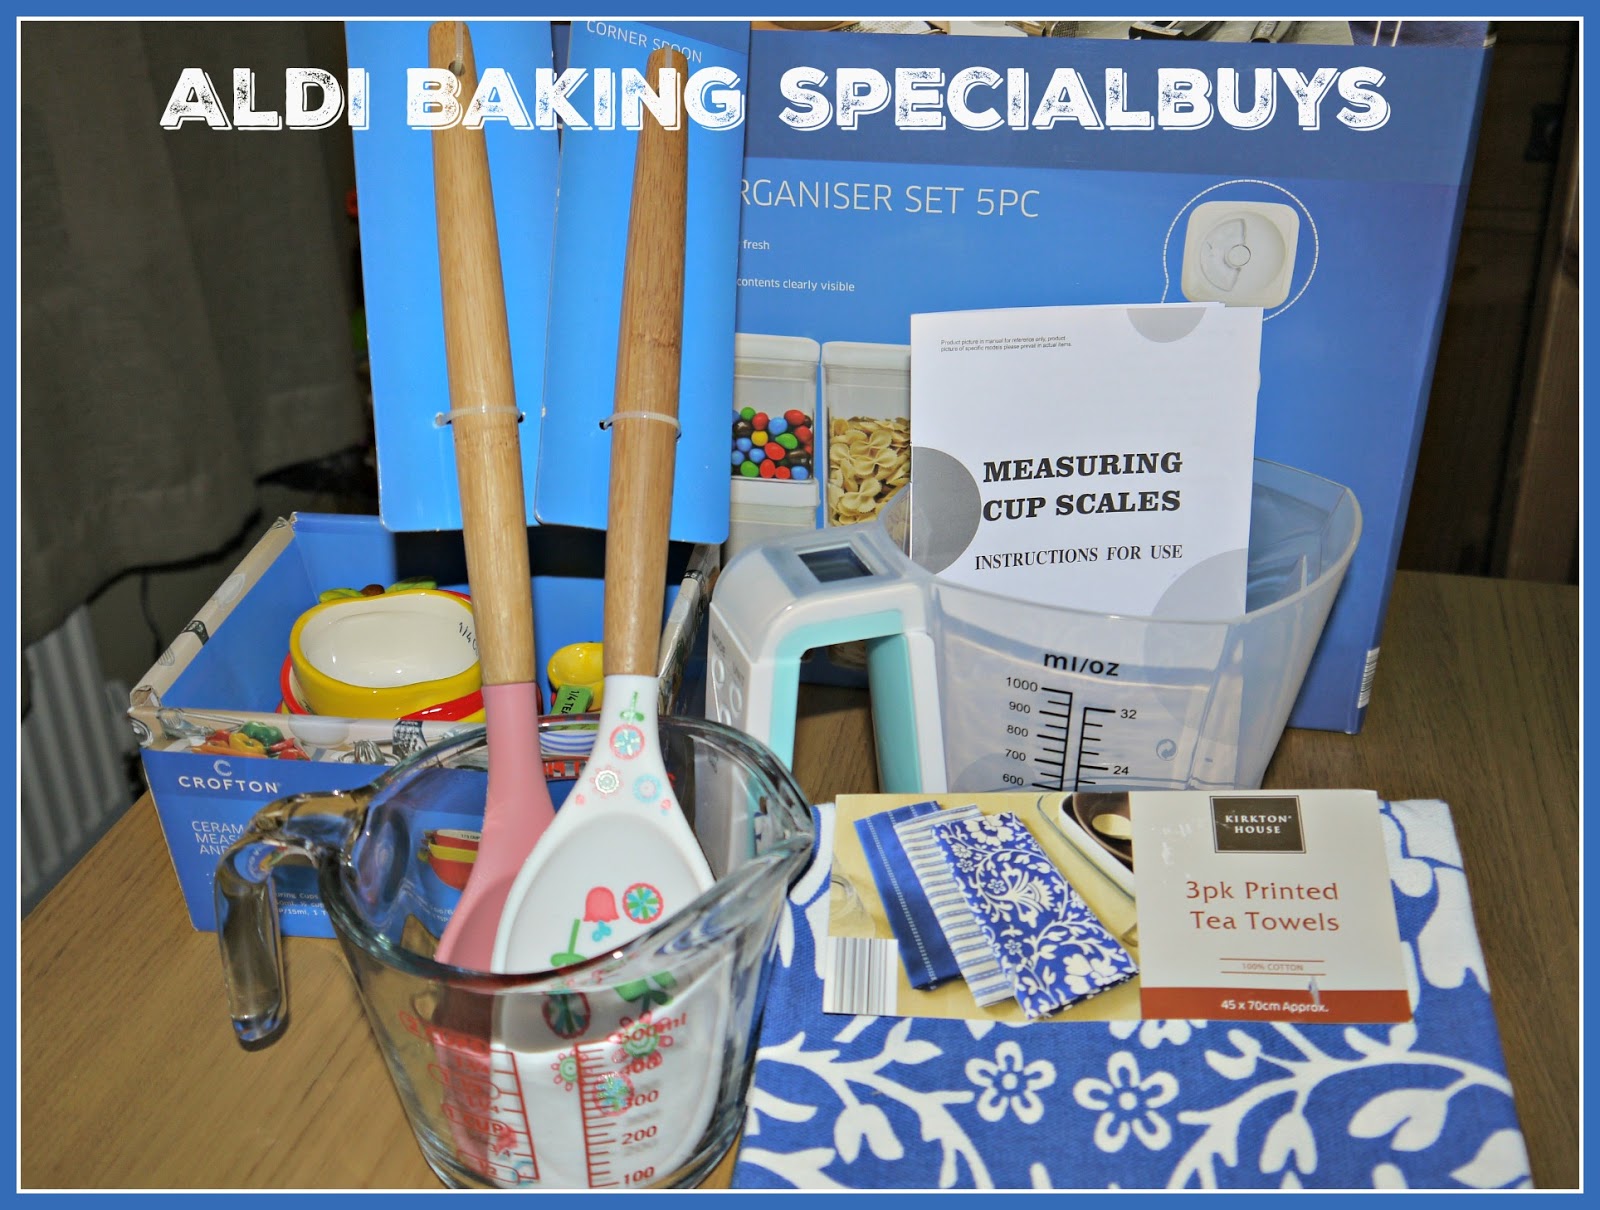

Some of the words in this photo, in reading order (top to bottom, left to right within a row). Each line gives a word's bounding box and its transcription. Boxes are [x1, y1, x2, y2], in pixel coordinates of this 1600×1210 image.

[586, 20, 648, 48] CORNER
[904, 185, 965, 215] SET
[976, 188, 1041, 218] 5PC
[742, 239, 770, 250] fresh
[737, 276, 780, 288] contents
[782, 279, 818, 292] clearly
[820, 281, 855, 292] visible
[982, 451, 1183, 483] MEASURING
[982, 496, 1047, 522] CUP
[1055, 490, 1181, 516] SCALES
[974, 547, 1099, 571] INSTRUCTIONS
[1105, 545, 1142, 561] FOR
[1150, 544, 1183, 560] USE
[1043, 653, 1120, 677] ml/oz
[1006, 676, 1039, 693] 1000
[566, 690, 580, 703] 1/4
[1008, 701, 1031, 714] 900
[1120, 708, 1137, 720] 32
[1006, 724, 1029, 738] 800
[1005, 748, 1027, 762] 700
[1112, 765, 1130, 776] 24
[178, 775, 279, 794] CROFTON
[1002, 773, 1025, 787] 600
[1234, 825, 1281, 835] HOUSE
[195, 832, 241, 846] MEAS
[1185, 880, 1235, 904] 3pk
[1245, 881, 1339, 901] Printed
[1190, 911, 1237, 931] Tea
[1244, 911, 1340, 932] Towels
[1242, 962, 1265, 972] 100%
[1267, 963, 1304, 972] COTTON
[1221, 1000, 1237, 1011] 45
[1238, 1002, 1245, 1011] x
[1247, 1000, 1281, 1012] 70cm
[621, 1125, 658, 1146] 200
[623, 1166, 656, 1186] 100
